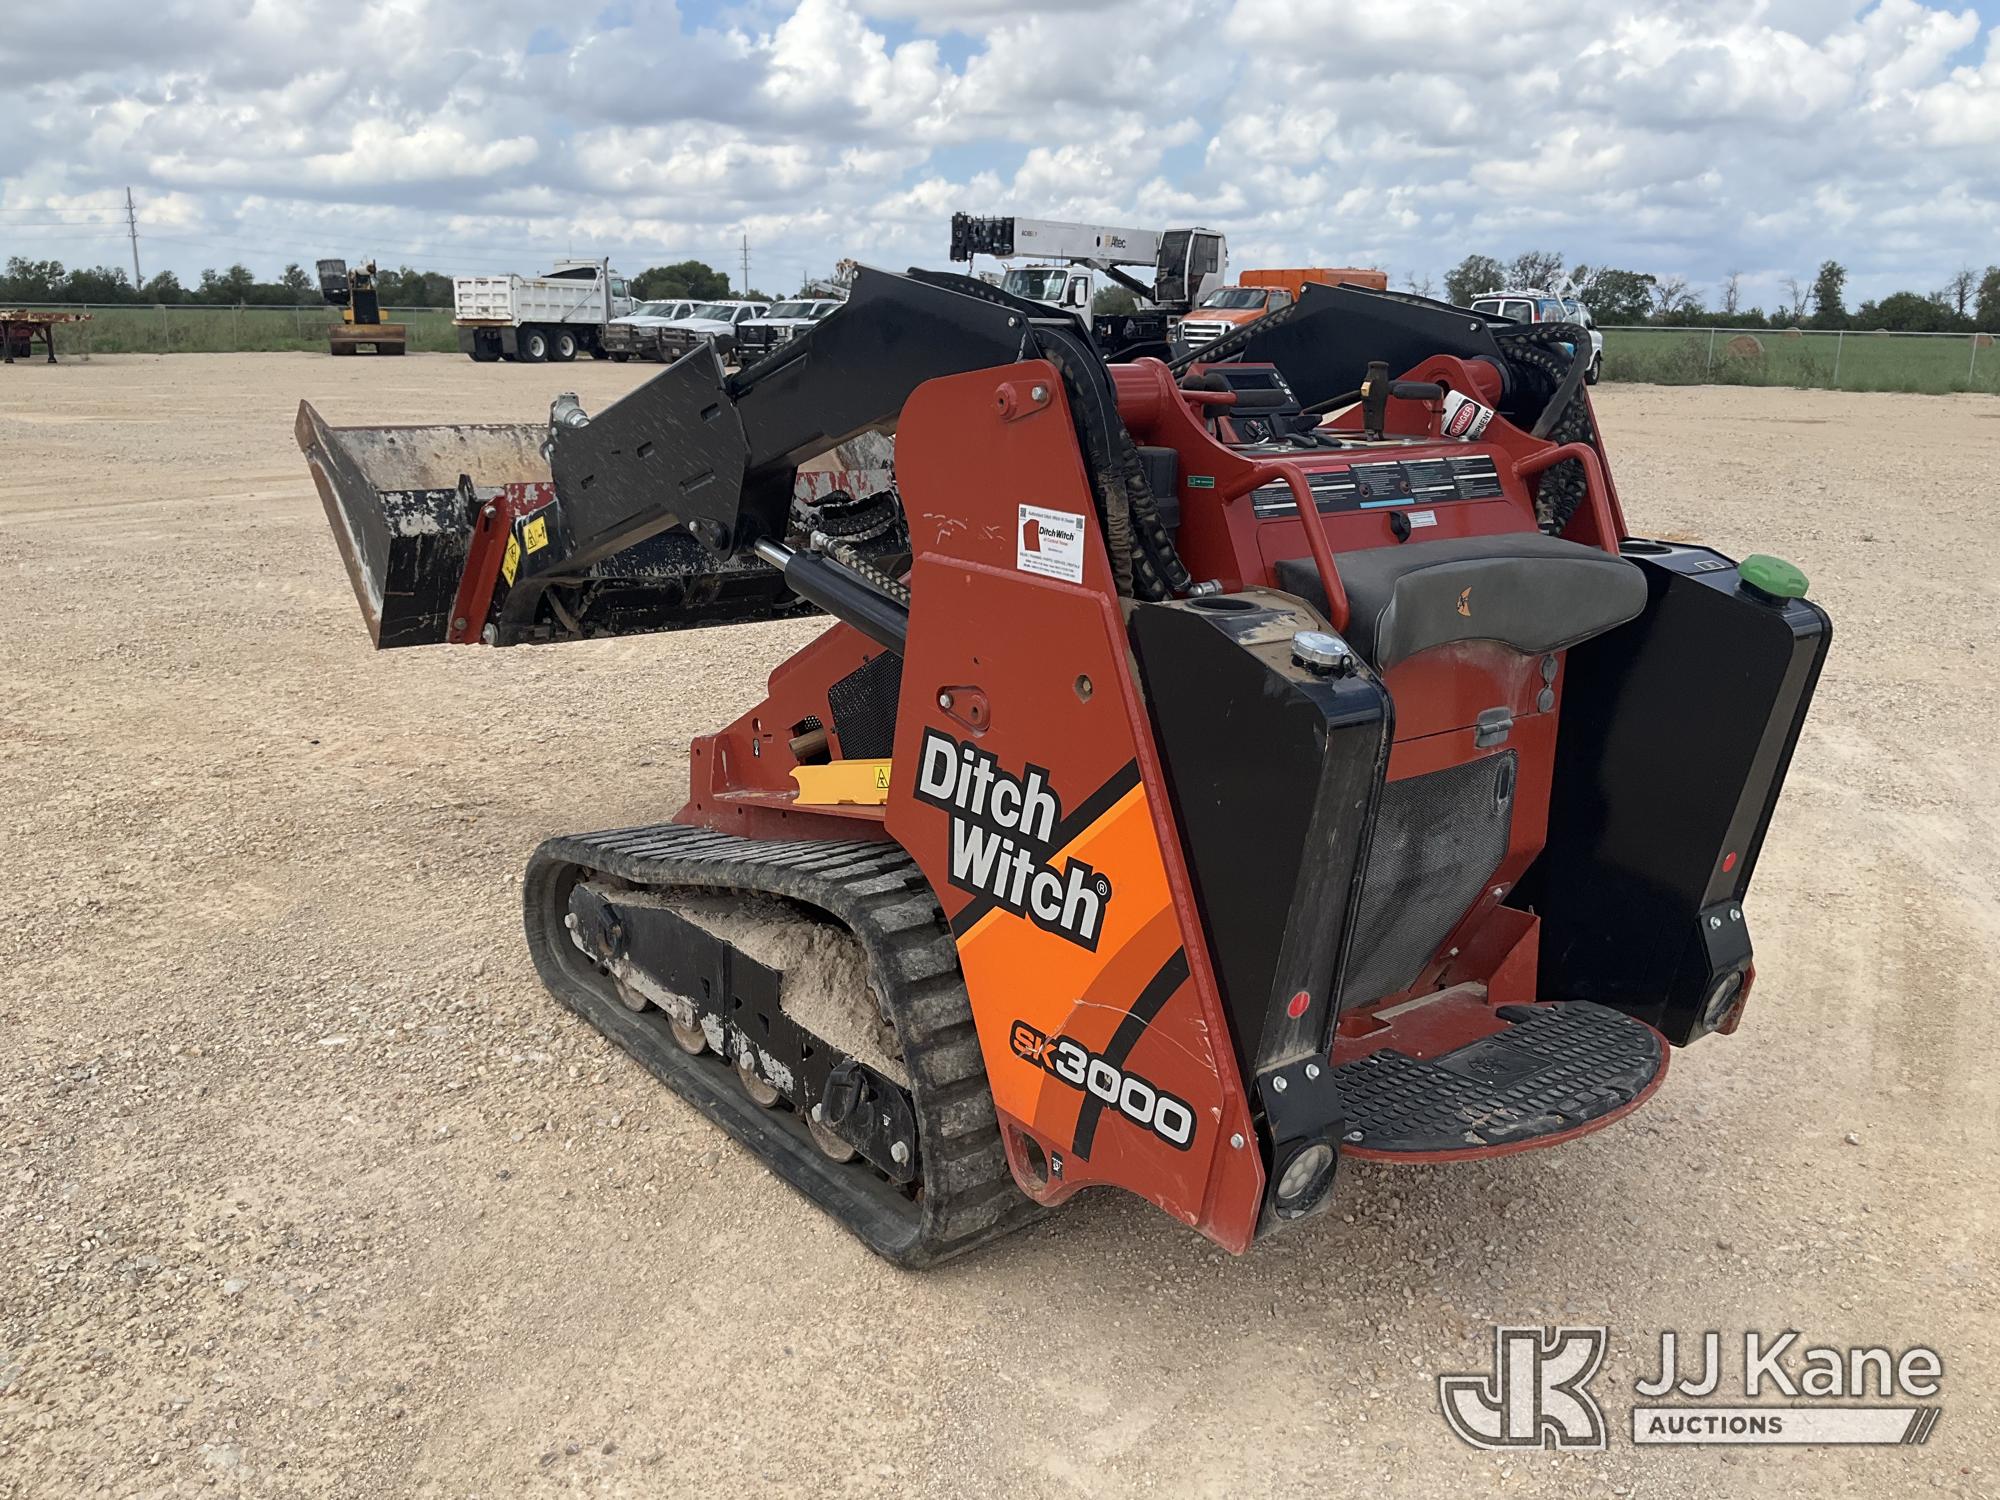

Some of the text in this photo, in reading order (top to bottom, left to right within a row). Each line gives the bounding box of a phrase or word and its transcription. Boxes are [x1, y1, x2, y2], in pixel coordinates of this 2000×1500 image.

[1452, 406, 1473, 434] DANGER
[1470, 410, 1492, 439] UIPMENT
[919, 735, 1056, 841] Ditch
[1013, 1026, 1192, 1144] SK3000
